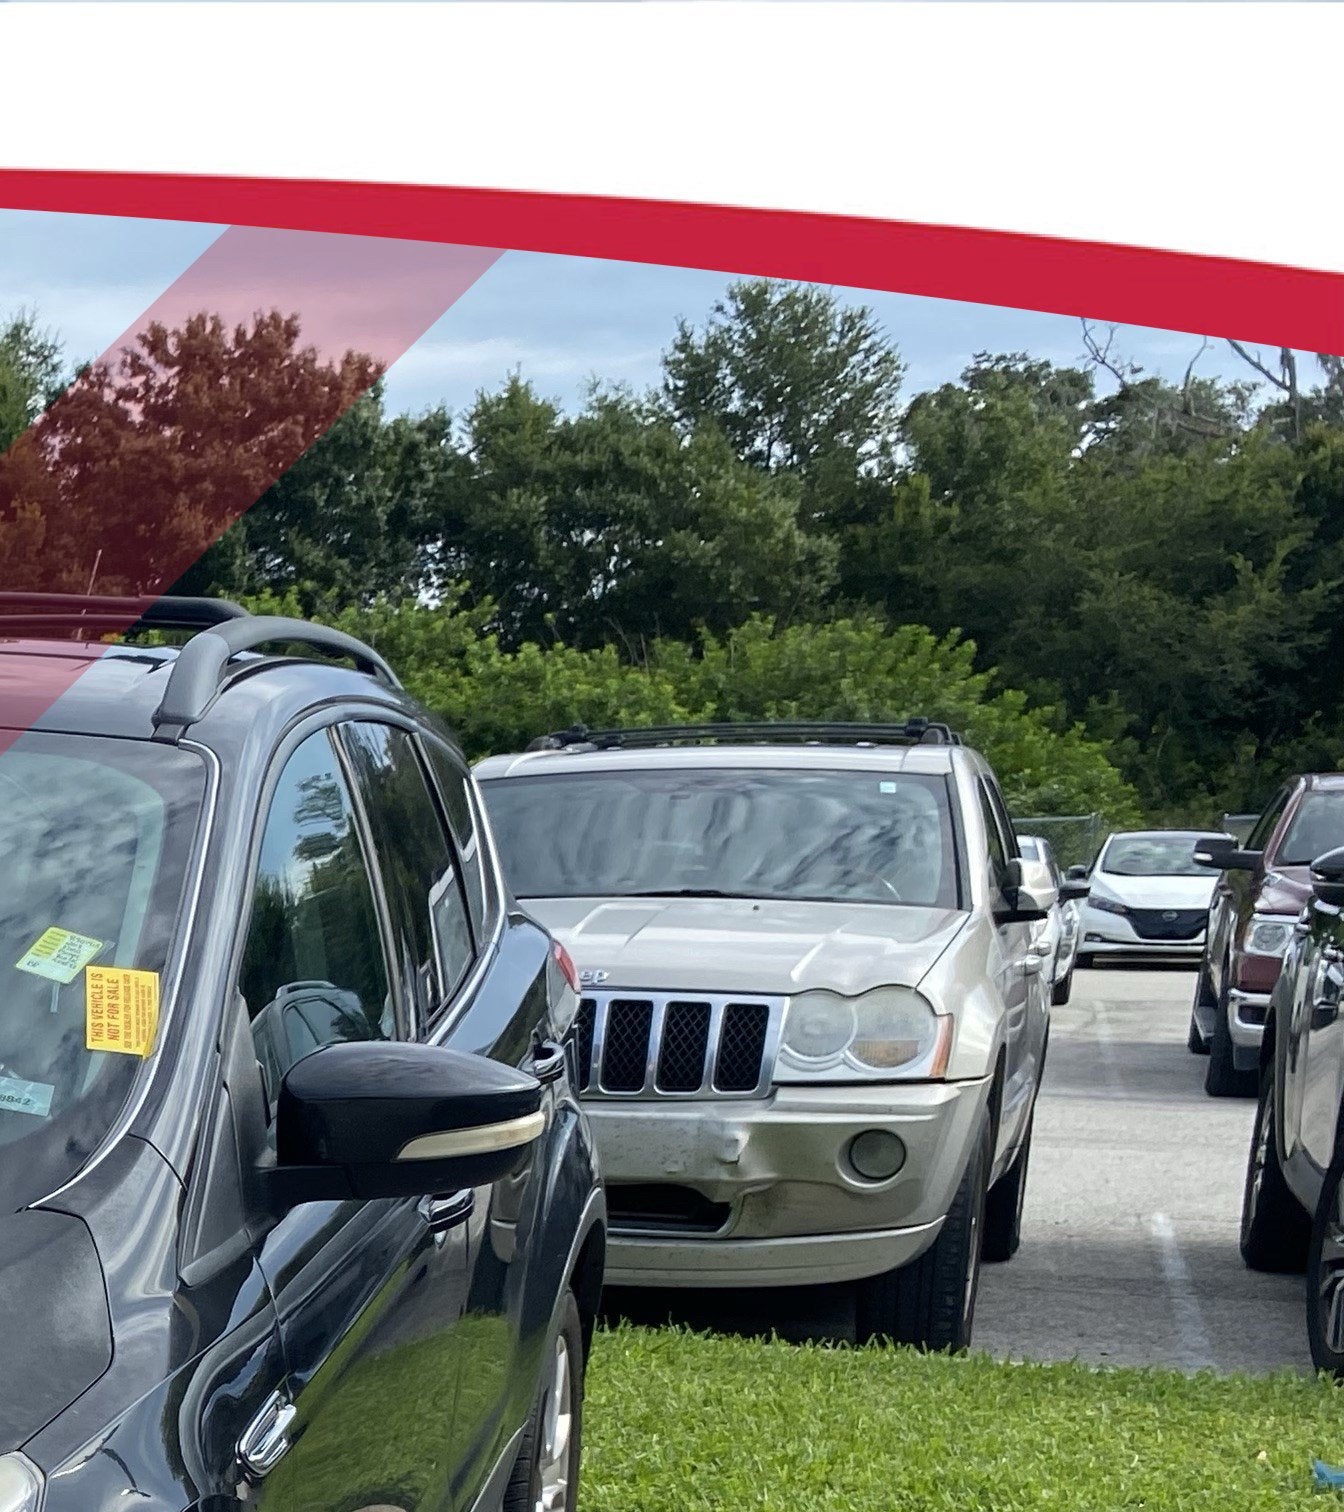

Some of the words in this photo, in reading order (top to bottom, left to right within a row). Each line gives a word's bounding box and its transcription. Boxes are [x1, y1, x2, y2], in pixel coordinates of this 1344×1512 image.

[90, 972, 103, 981] IS
[580, 969, 610, 984] ep
[107, 978, 119, 1001] SALE
[90, 984, 104, 1020] VEHICLE
[107, 1003, 119, 1020] FOR
[91, 1022, 104, 1042] THIS
[107, 1022, 120, 1041] NOT
